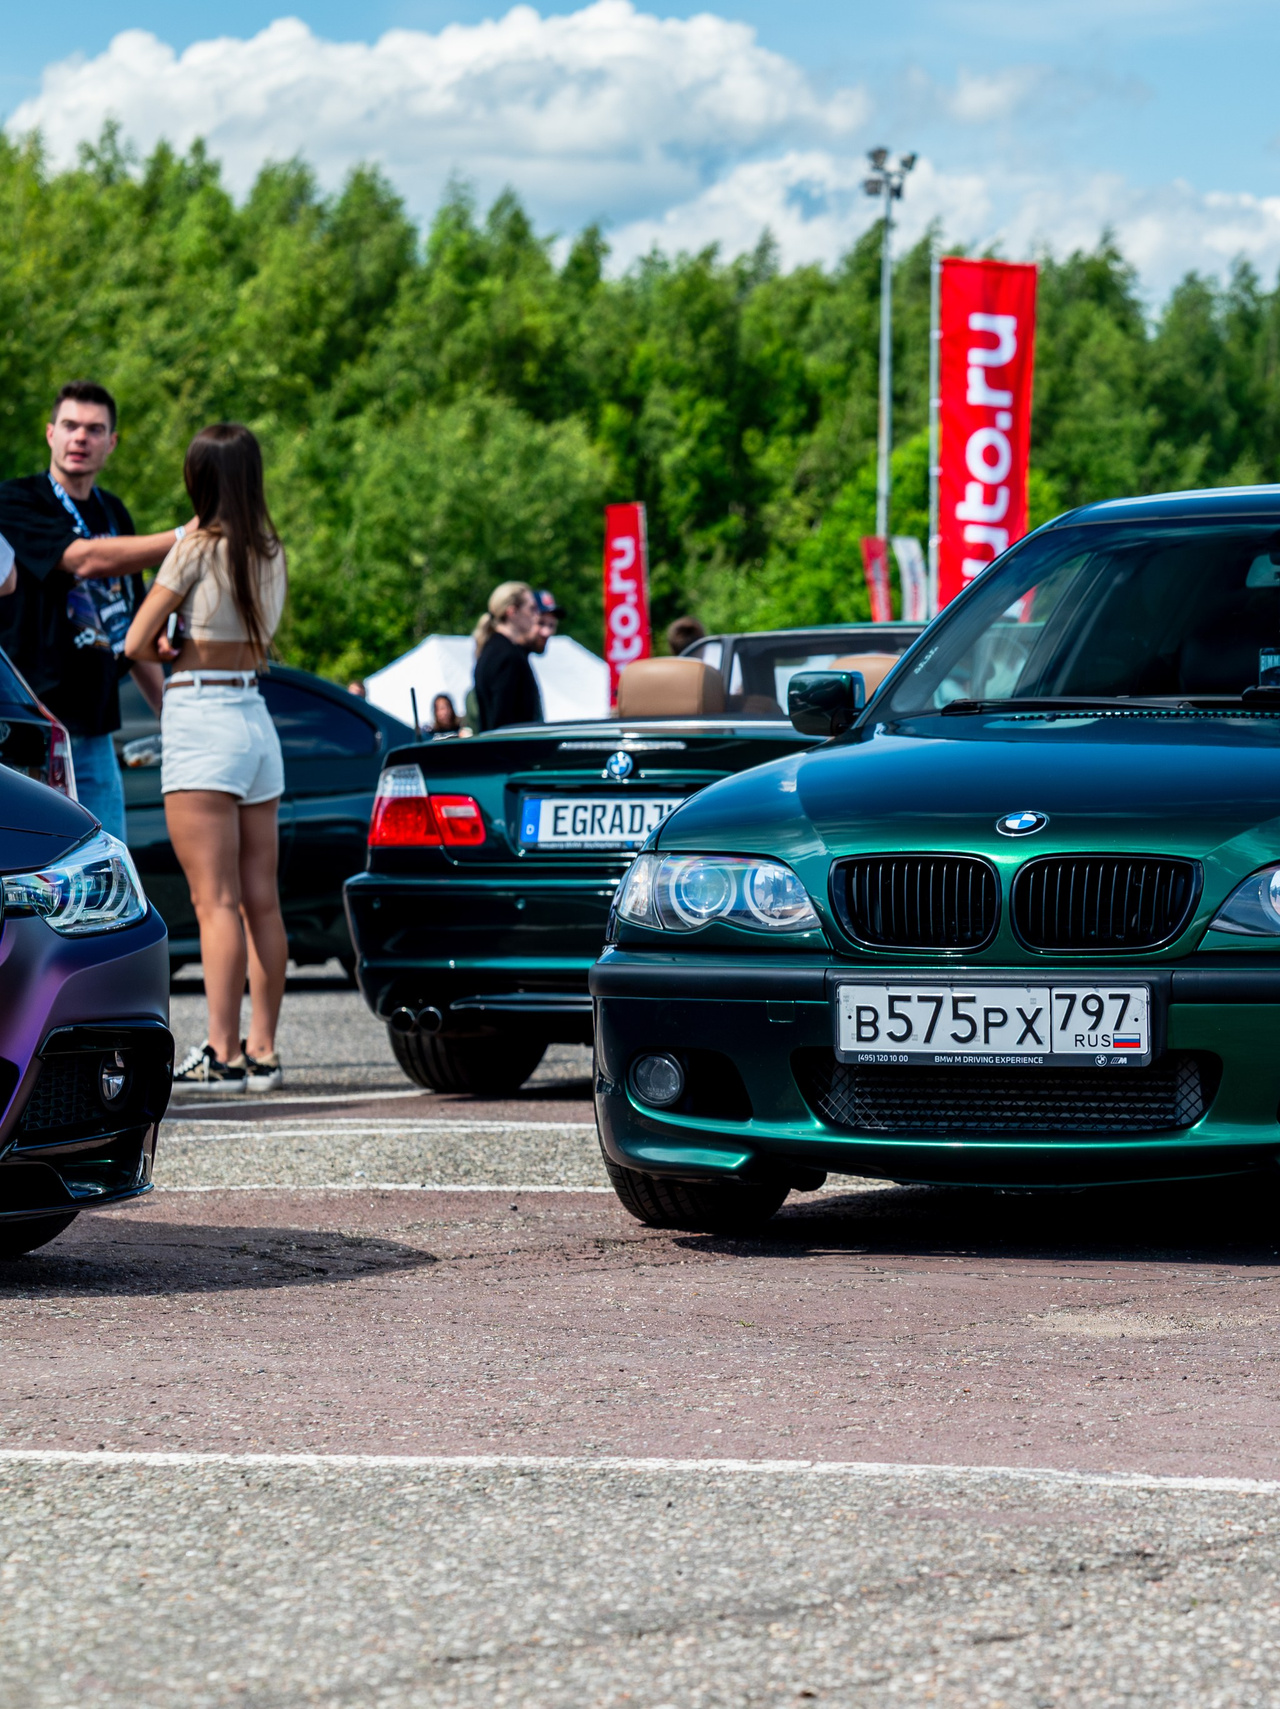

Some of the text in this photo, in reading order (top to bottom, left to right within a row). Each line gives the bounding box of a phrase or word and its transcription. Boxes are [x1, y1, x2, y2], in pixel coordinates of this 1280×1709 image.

[954, 311, 1018, 588] uto.ru
[609, 535, 643, 674] to.ru
[552, 804, 673, 836] EGRADJ
[1054, 993, 1131, 1031] 797
[1074, 1033, 1112, 1048] RUS
[858, 1053, 909, 1063] (495) 120 10 00
[934, 1055, 953, 1063] BMW
[962, 1056, 994, 1064] DRIVING
[995, 1056, 1044, 1064] EXPERIENCE
